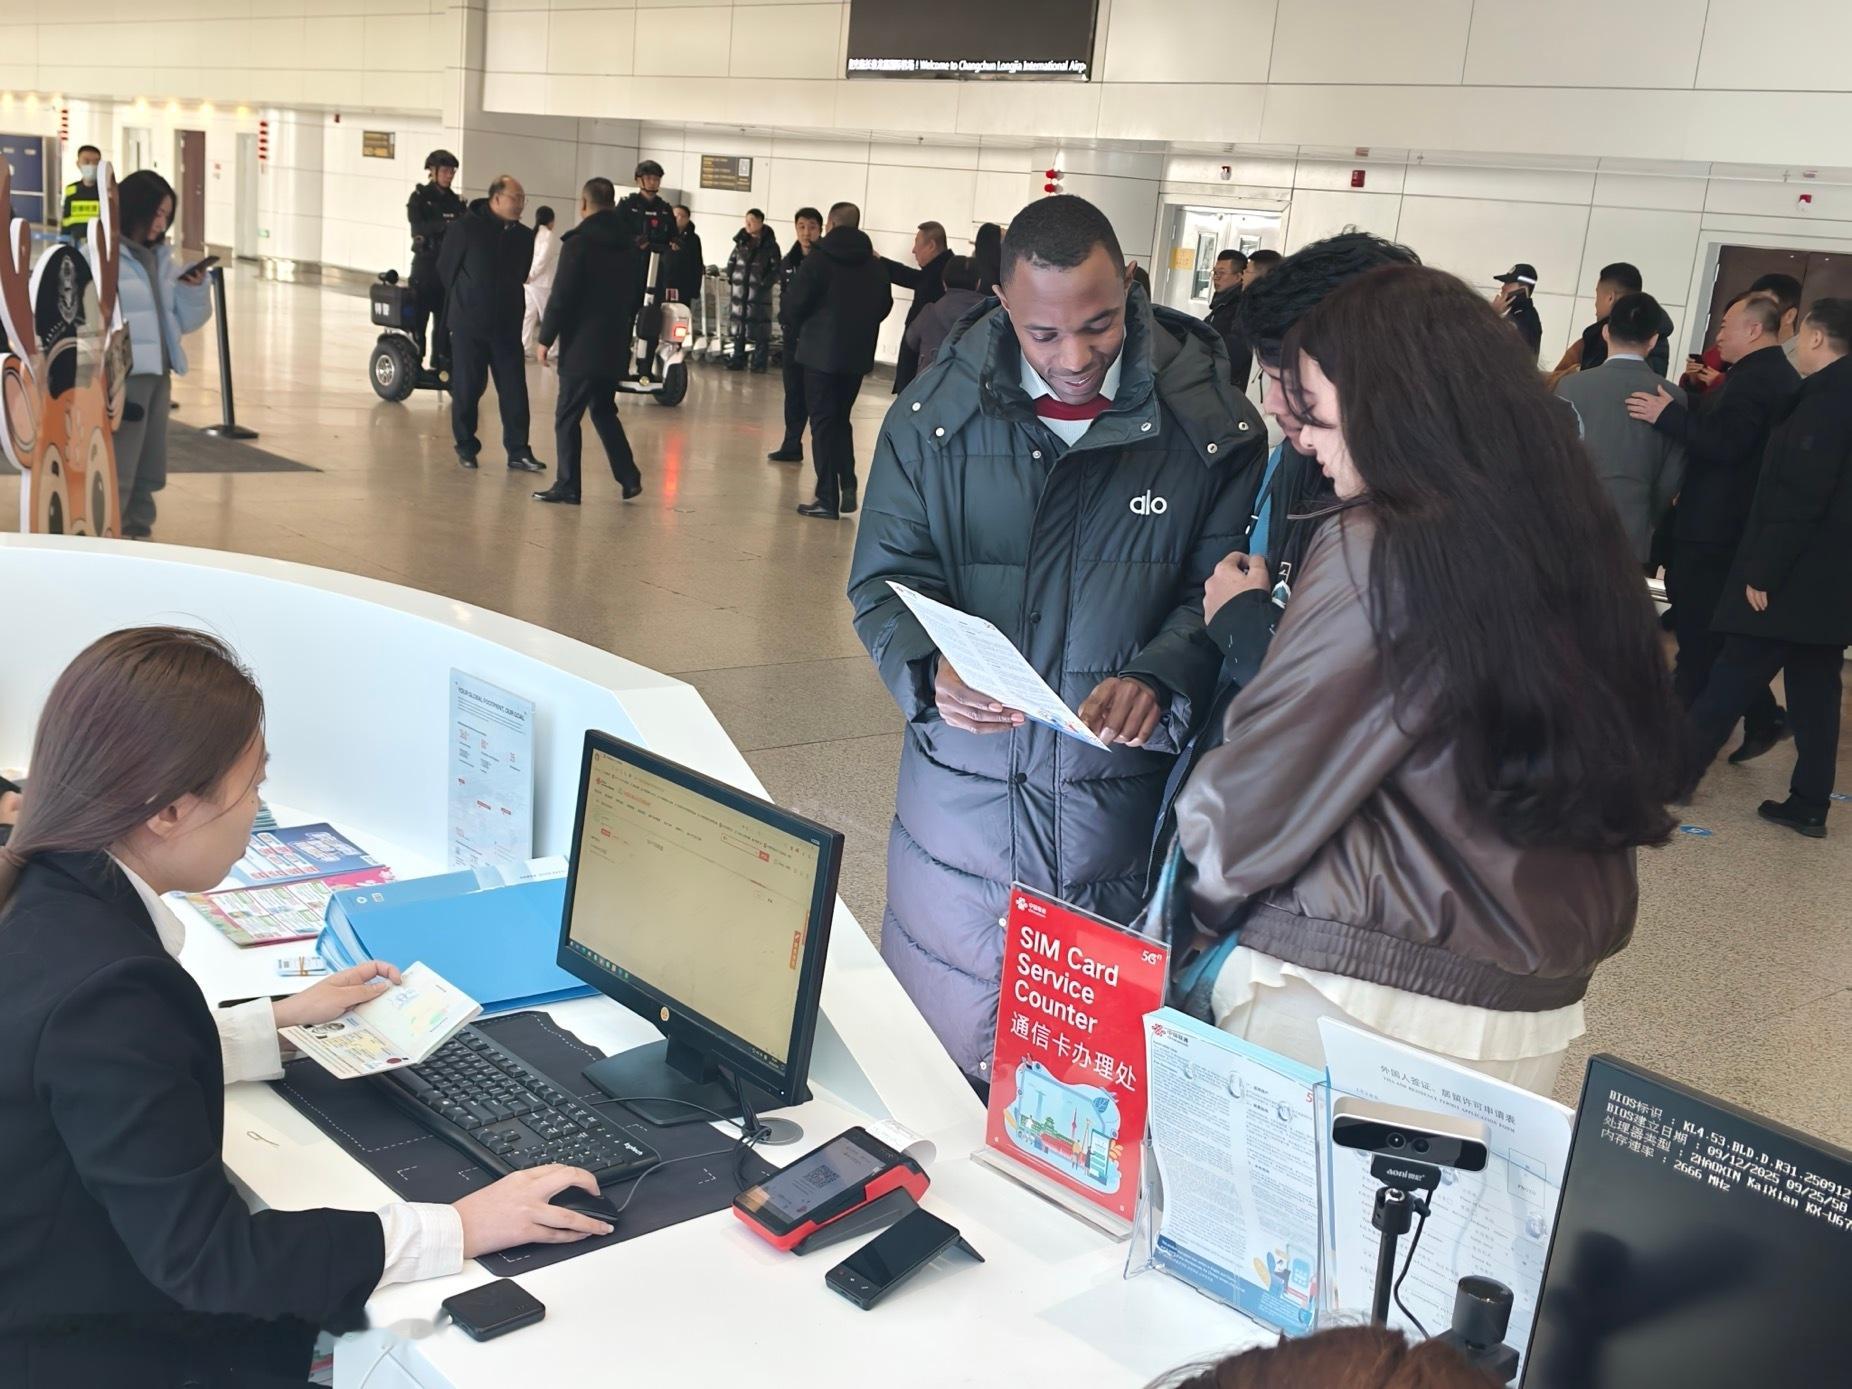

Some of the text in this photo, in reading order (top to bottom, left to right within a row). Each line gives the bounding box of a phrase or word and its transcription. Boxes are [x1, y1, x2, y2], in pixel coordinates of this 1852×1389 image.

[920, 59, 950, 71] Welcome
[1023, 60, 1069, 71] International
[1129, 489, 1167, 515] alo
[1016, 953, 1095, 1005] Service
[1019, 926, 1119, 987] SIM Card
[1014, 979, 1098, 1034] Counter
[1010, 1011, 1136, 1092] 通信卡办理处
[1609, 1089, 1663, 1119] BIOS标识
[1600, 1128, 1655, 1158] 内存速率
[1673, 1159, 1703, 1180] 2666
[1707, 1174, 1731, 1192] MHz
[1606, 1102, 1688, 1146] BIOS建立日期
[1707, 1145, 1780, 1184] 09/12/2025
[1603, 1115, 1672, 1152] 处理器类型
[1746, 1176, 1799, 1209] KaiXian
[1805, 1201, 1852, 1231] KX-U67
